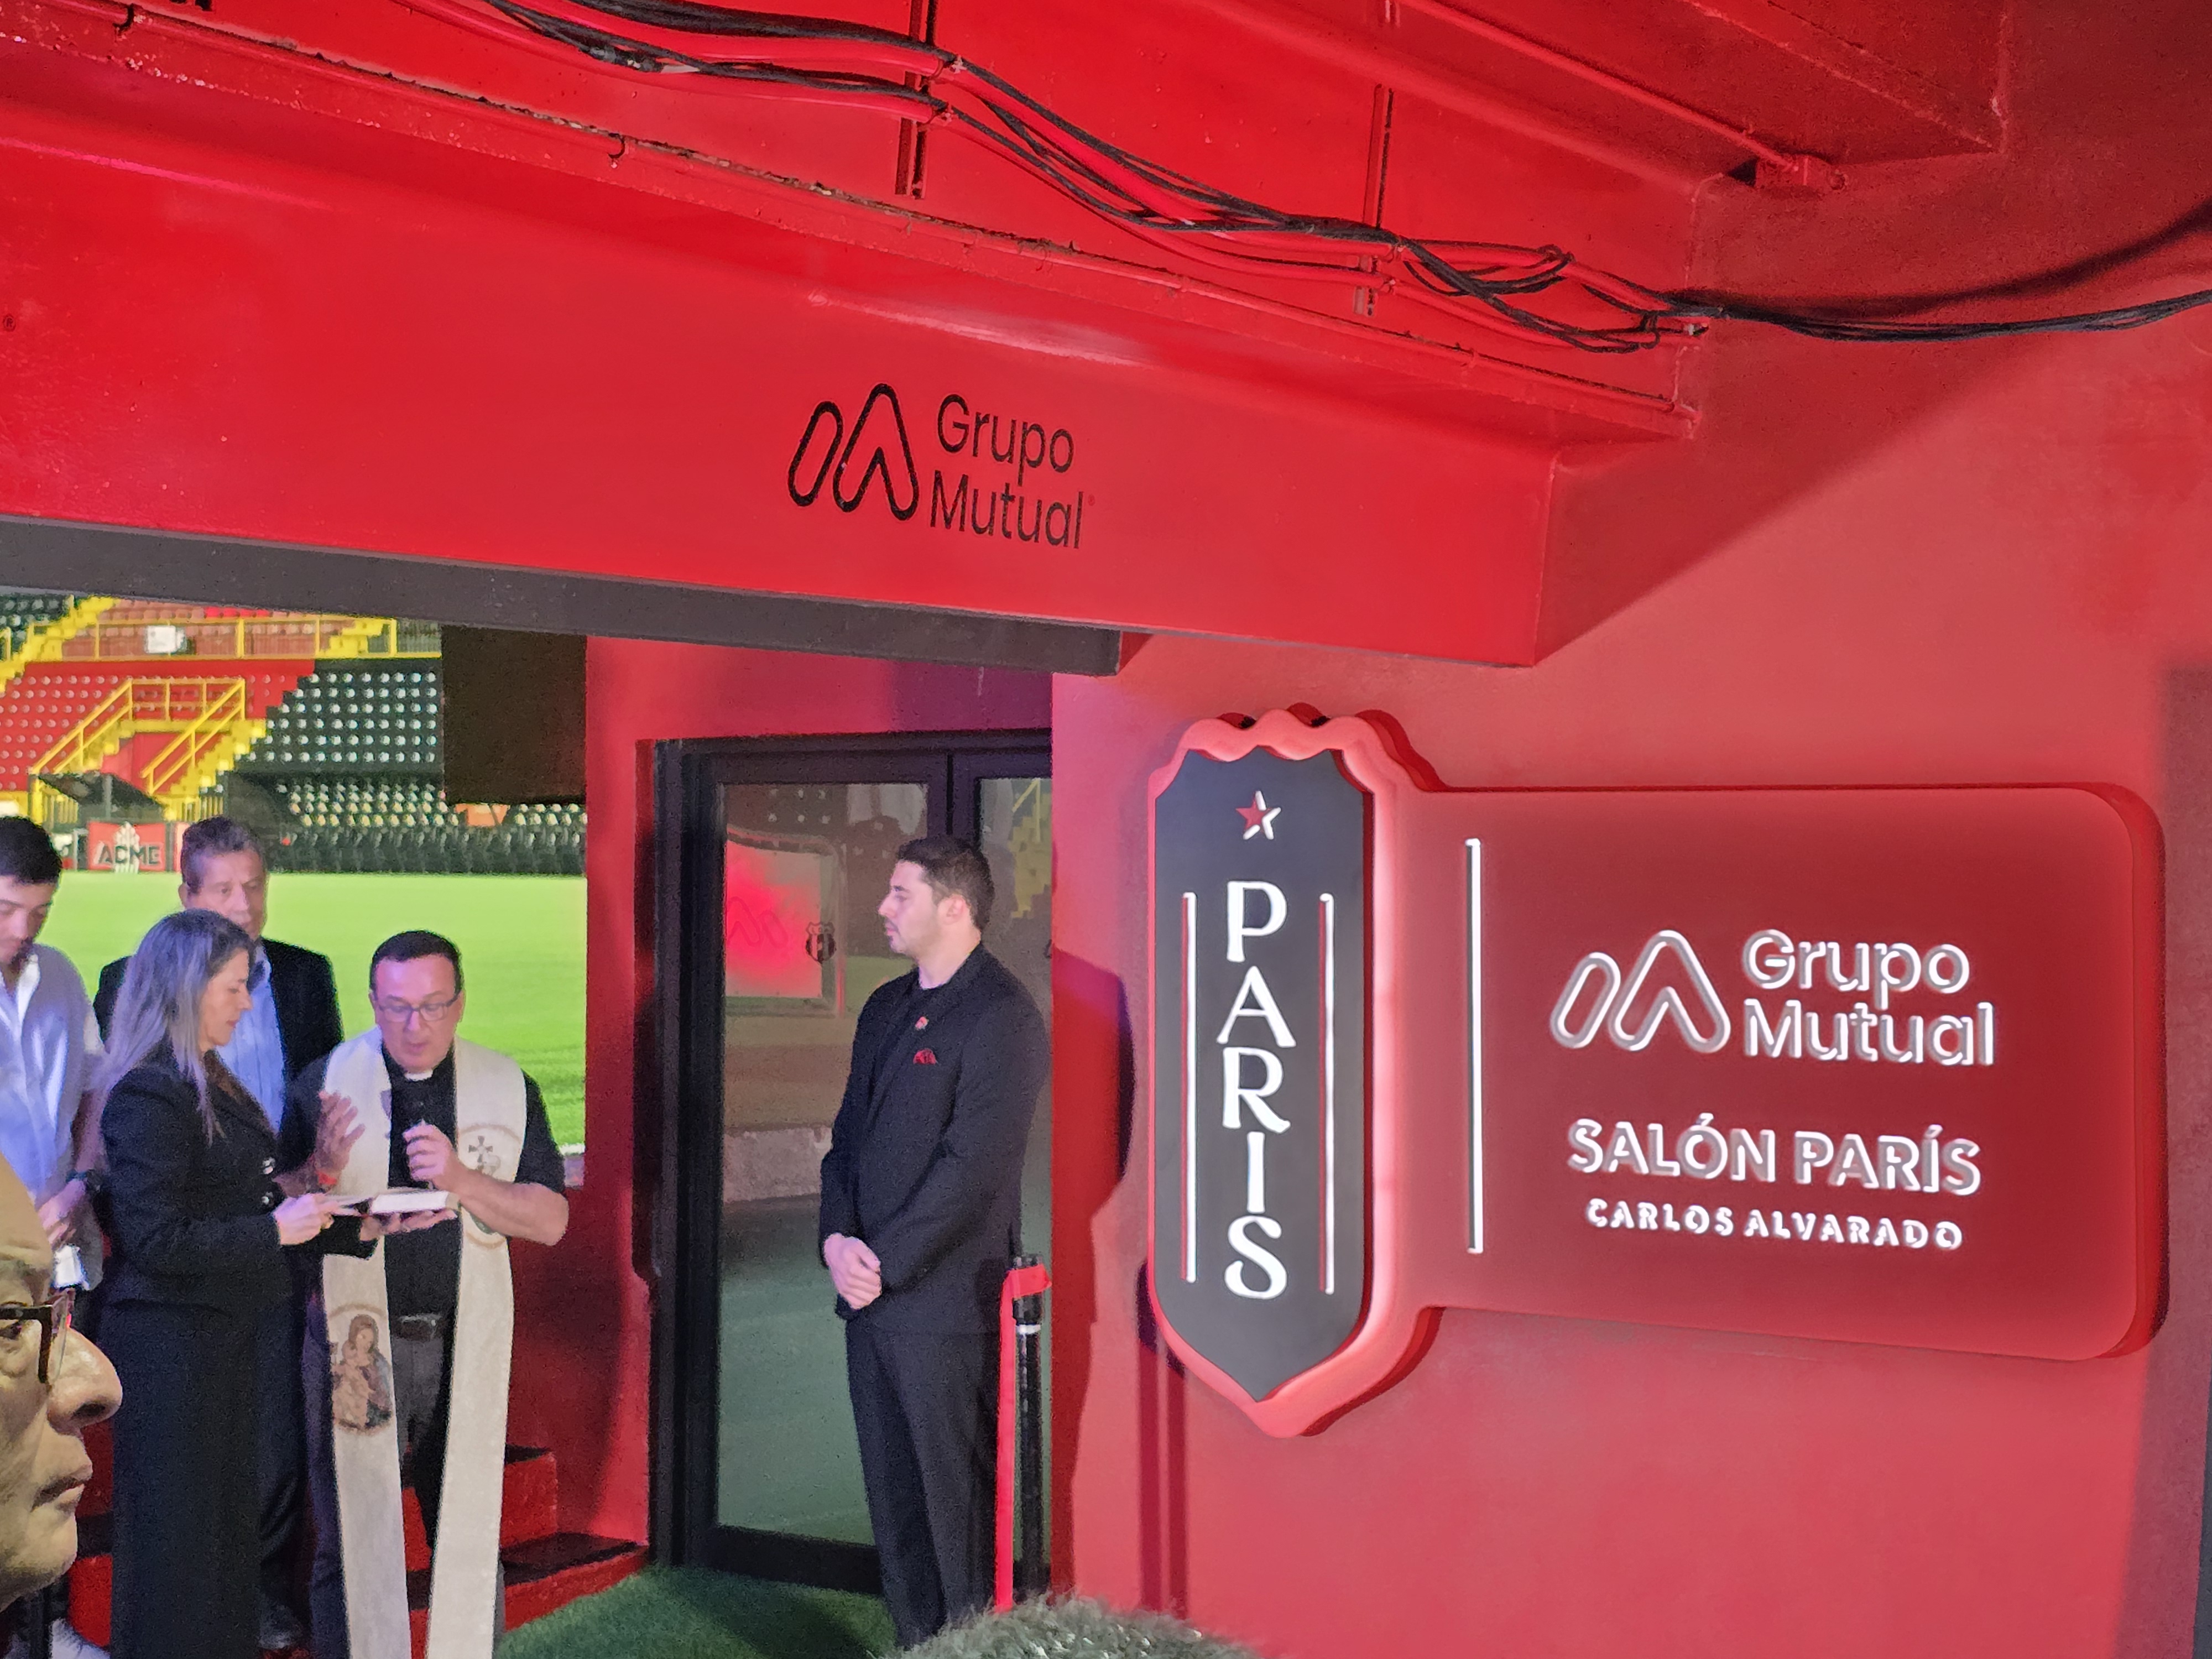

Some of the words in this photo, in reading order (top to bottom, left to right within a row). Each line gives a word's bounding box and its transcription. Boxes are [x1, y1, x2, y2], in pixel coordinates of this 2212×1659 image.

[938, 394, 1074, 487] Grupo
[931, 470, 1083, 549] Mutual
[1743, 929, 1970, 1009] Grupo
[1744, 999, 1994, 1066] Mutual
[1217, 881, 1296, 1300] PARIS
[1568, 1113, 1776, 1183] SALÓN
[1794, 1125, 1981, 1195] PARÍS
[1587, 1198, 1734, 1235] CARLOS
[1744, 1210, 1963, 1250] ALVARADO
